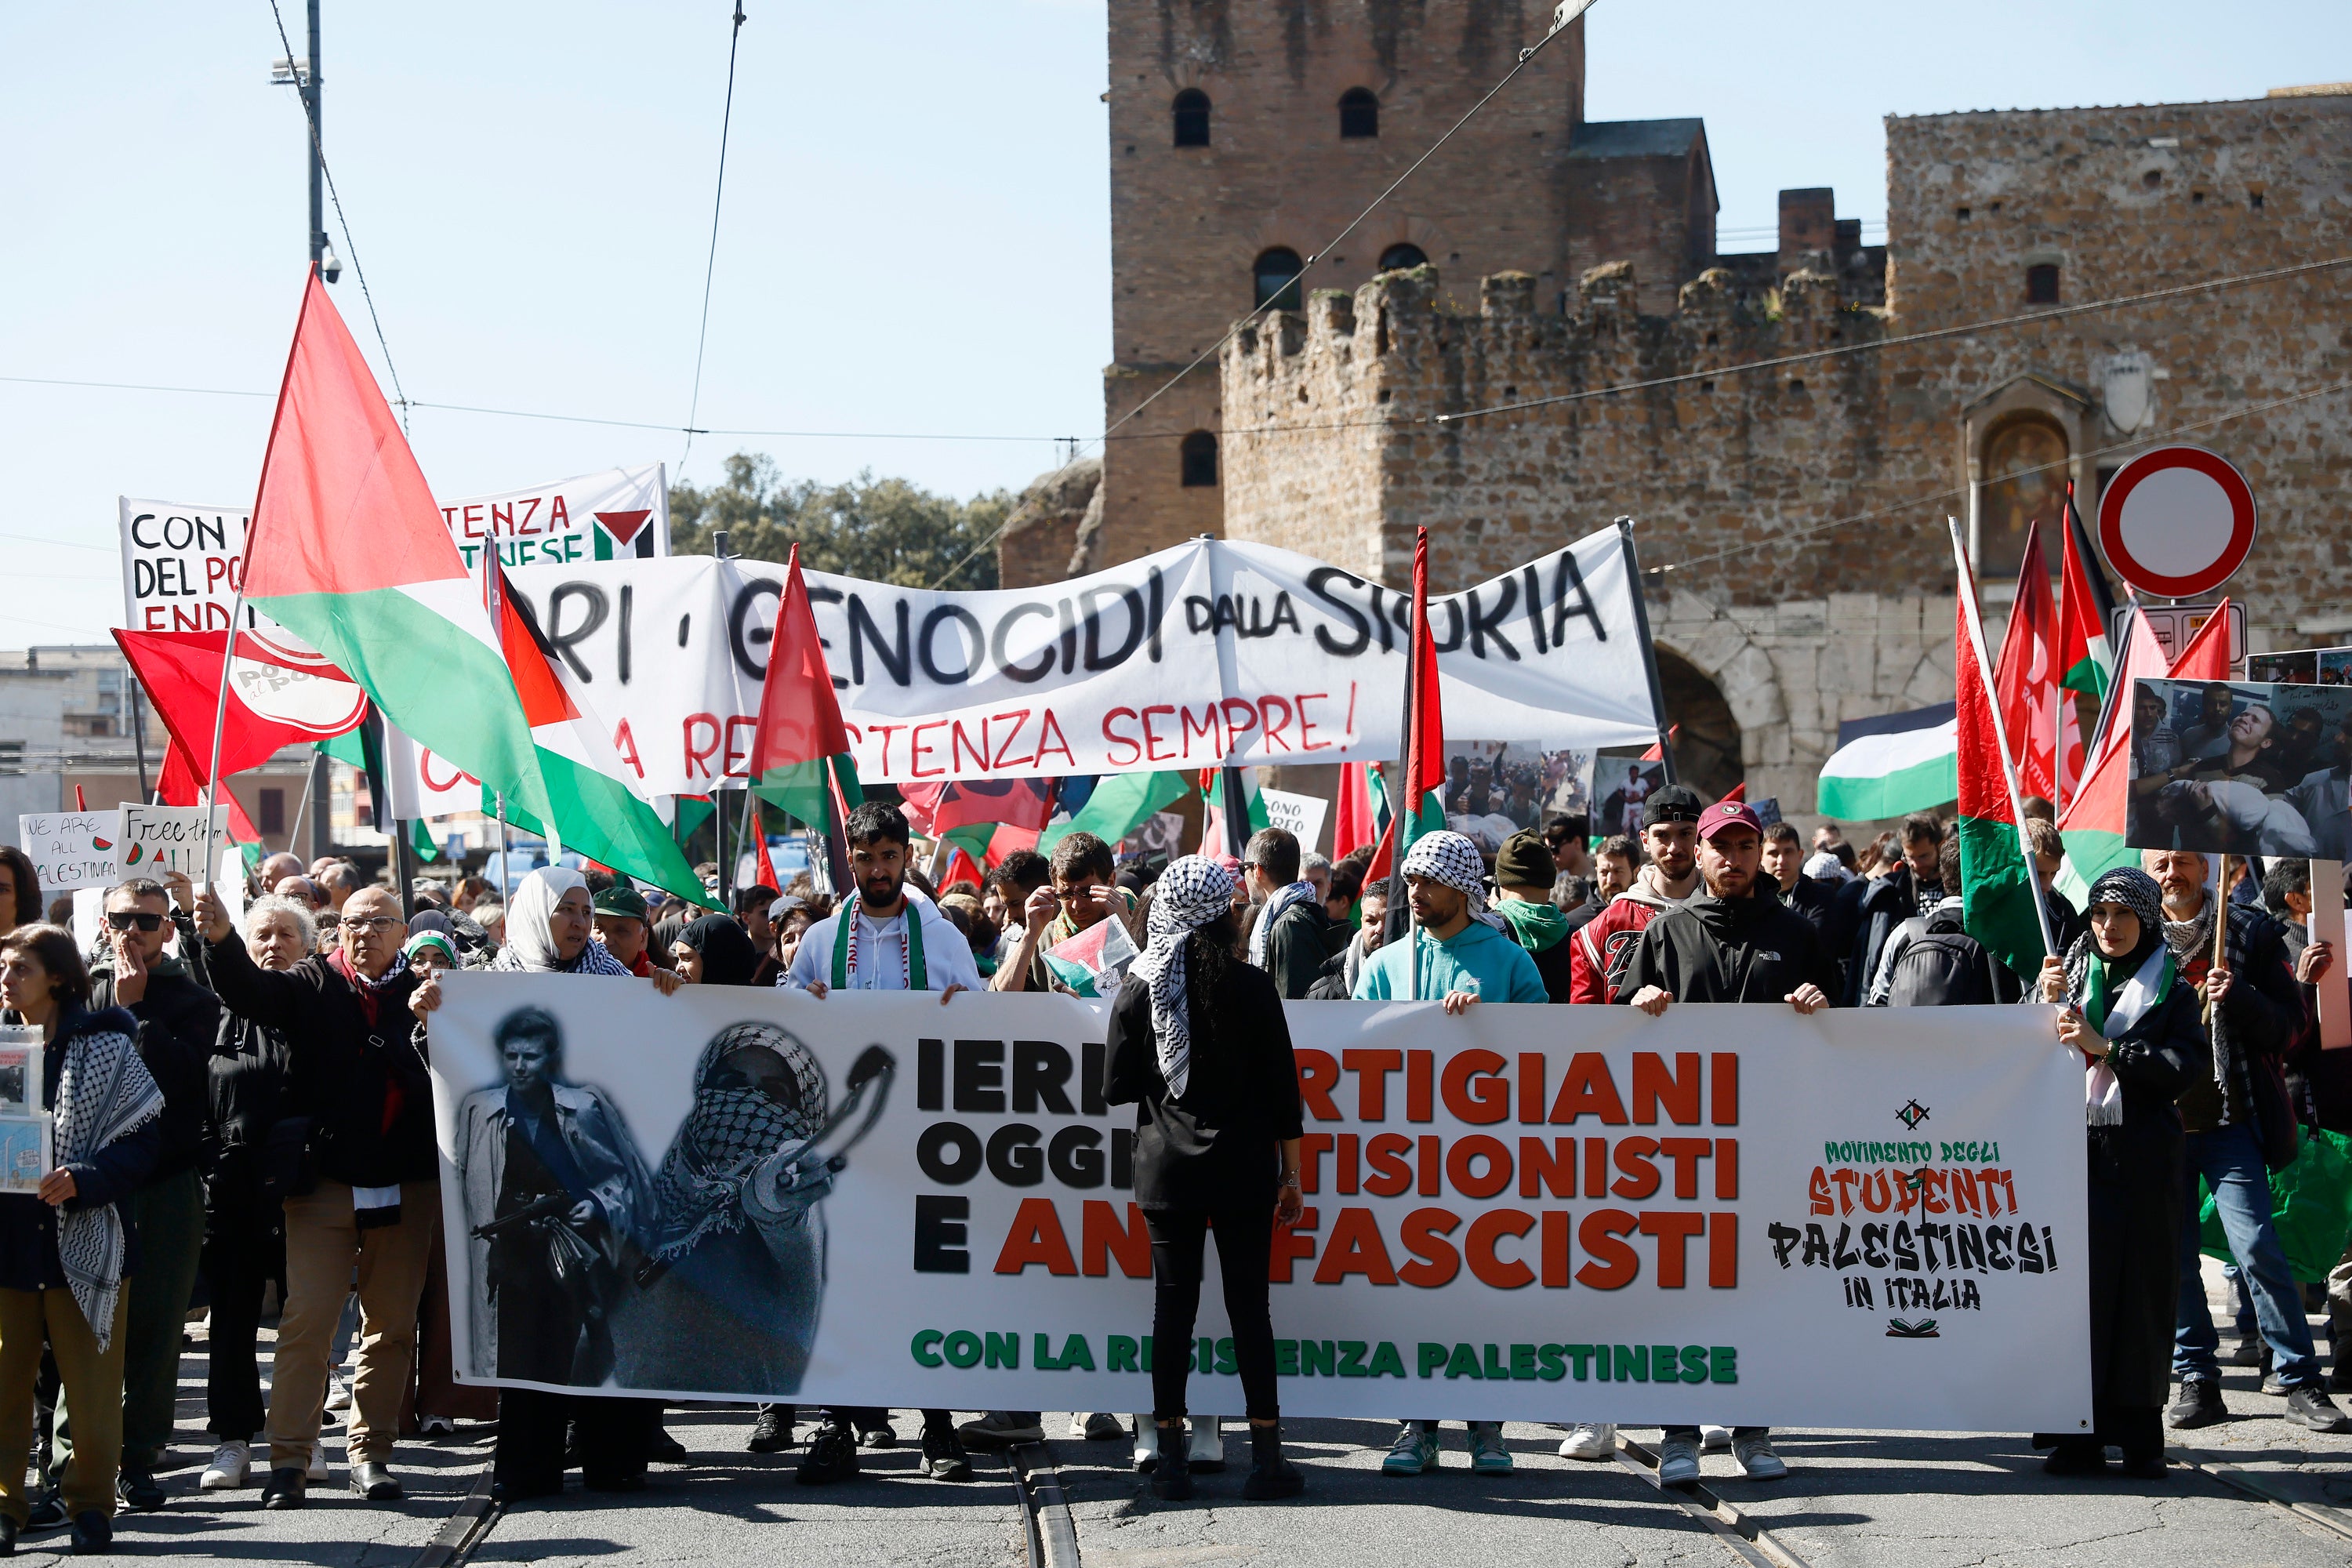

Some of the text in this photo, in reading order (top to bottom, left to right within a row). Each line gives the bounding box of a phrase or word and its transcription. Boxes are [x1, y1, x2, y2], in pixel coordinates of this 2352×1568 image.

[132, 514, 226, 550] CON
[441, 495, 570, 538] TENZA
[134, 557, 197, 598] DEL
[517, 580, 632, 684] RI
[1185, 590, 1301, 637] DALLA
[24, 817, 101, 836] WE ARE
[127, 809, 222, 842] Free thm
[1266, 800, 1301, 816] ONO
[1269, 816, 1304, 832] REO
[51, 840, 77, 855] ALL
[917, 1038, 1737, 1125] IERI RTIGIANI
[916, 1121, 1737, 1199] OGGI TISIONISTI
[1824, 1140, 2001, 1164] MOVIMENTO DEGLI
[1808, 1165, 2019, 1219] STUDENTI
[913, 1194, 1737, 1289] E ANFASCISTI
[1767, 1219, 2059, 1275] PALESTINESI
[1842, 1276, 1981, 1312] IN ITALIA
[910, 1329, 1737, 1383] CON LA RISENZA PALESTINESE
